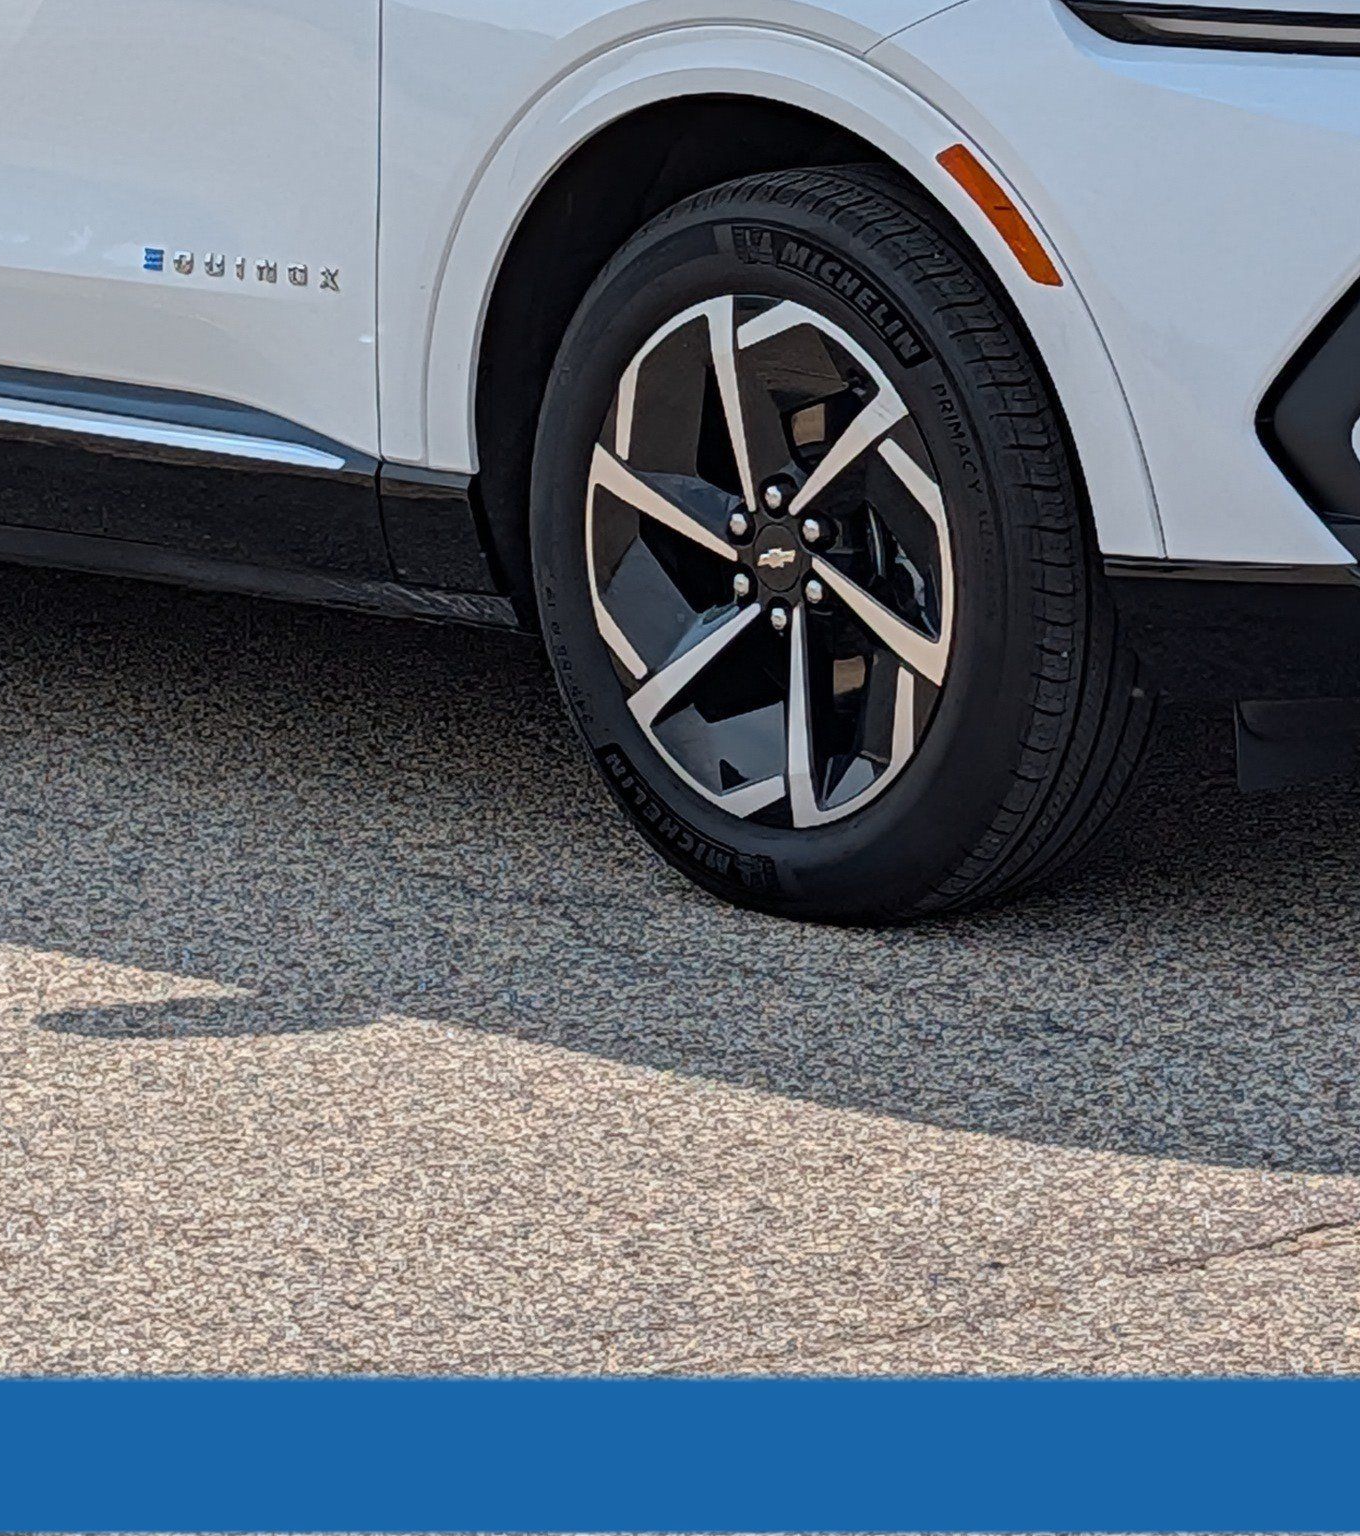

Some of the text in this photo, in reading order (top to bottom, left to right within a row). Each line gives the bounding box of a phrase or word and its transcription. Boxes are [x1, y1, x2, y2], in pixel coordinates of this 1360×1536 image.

[781, 239, 922, 360] MICHELIN
[931, 383, 984, 494] PRIMACY
[603, 752, 732, 876] MICHELIN
